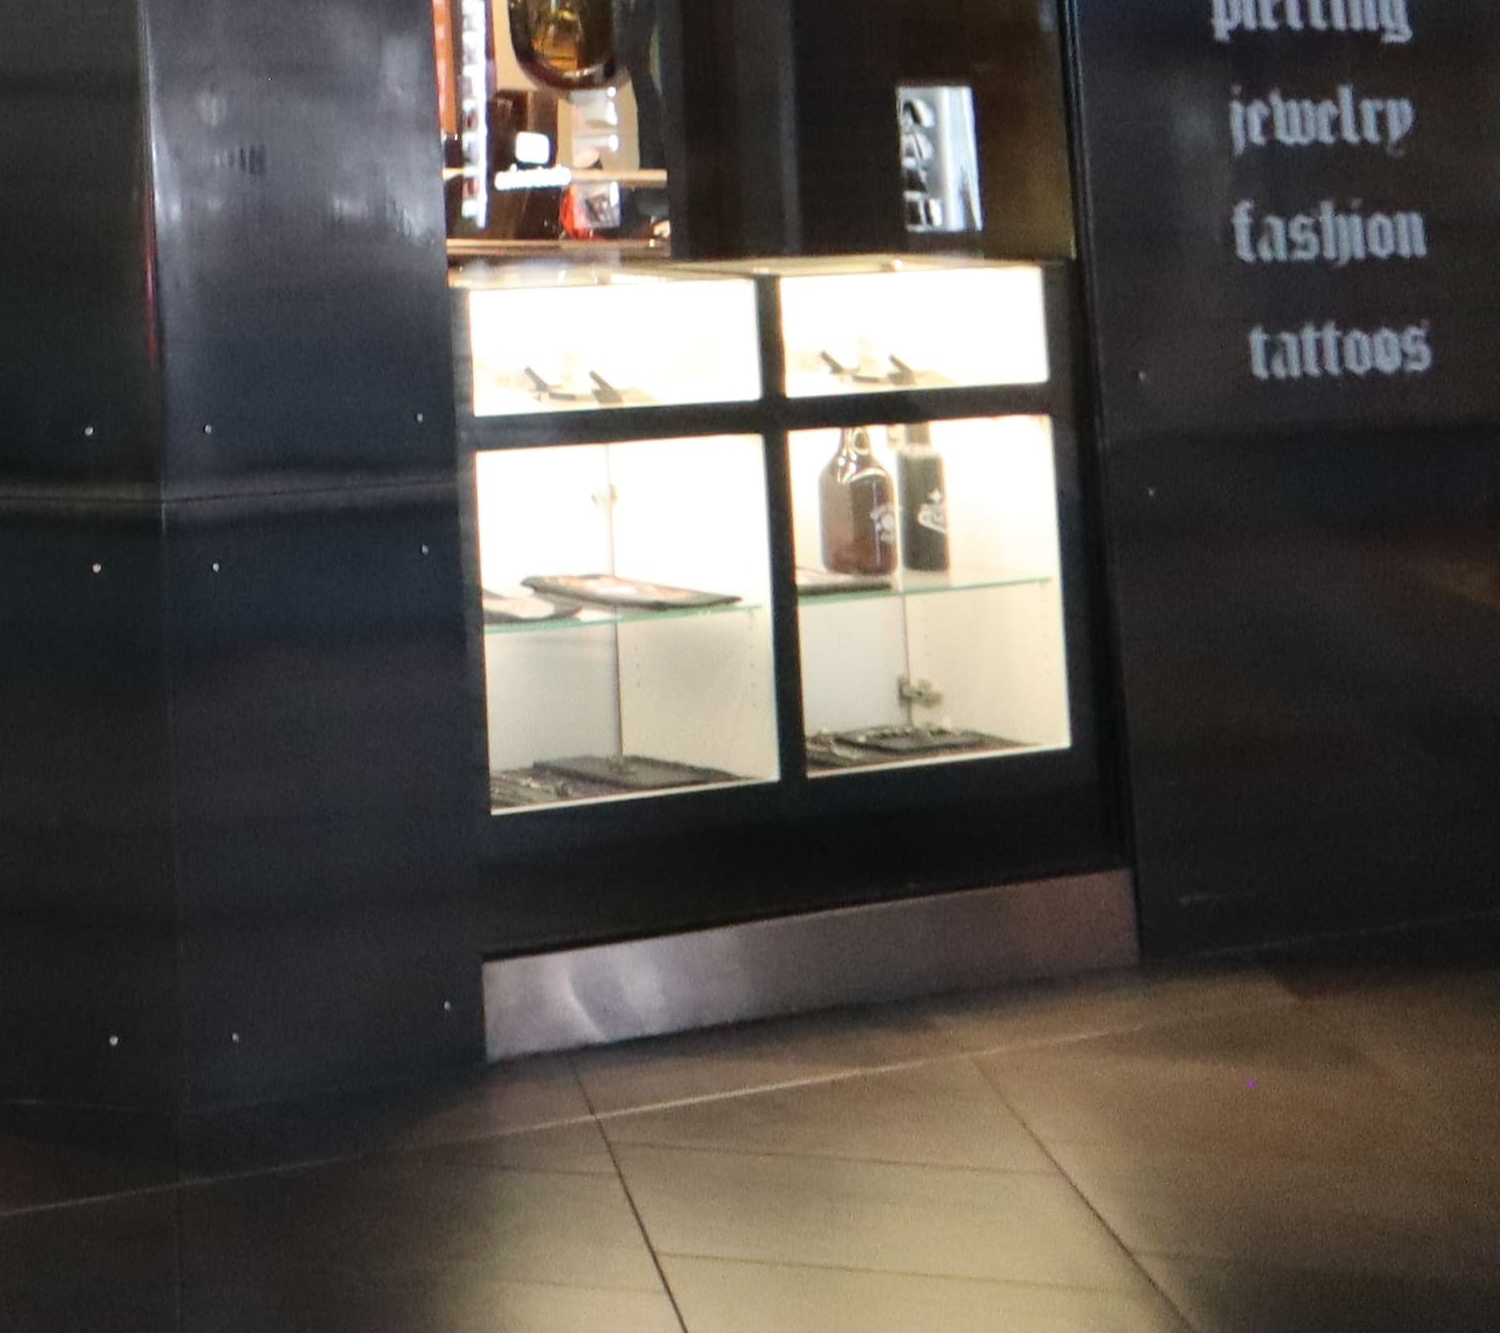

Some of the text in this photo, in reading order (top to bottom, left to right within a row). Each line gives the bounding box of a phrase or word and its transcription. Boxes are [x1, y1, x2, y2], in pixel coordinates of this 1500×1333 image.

[1229, 84, 1415, 157] jewelry
[1231, 199, 1427, 267] fashion
[1249, 319, 1432, 379] tattoos
